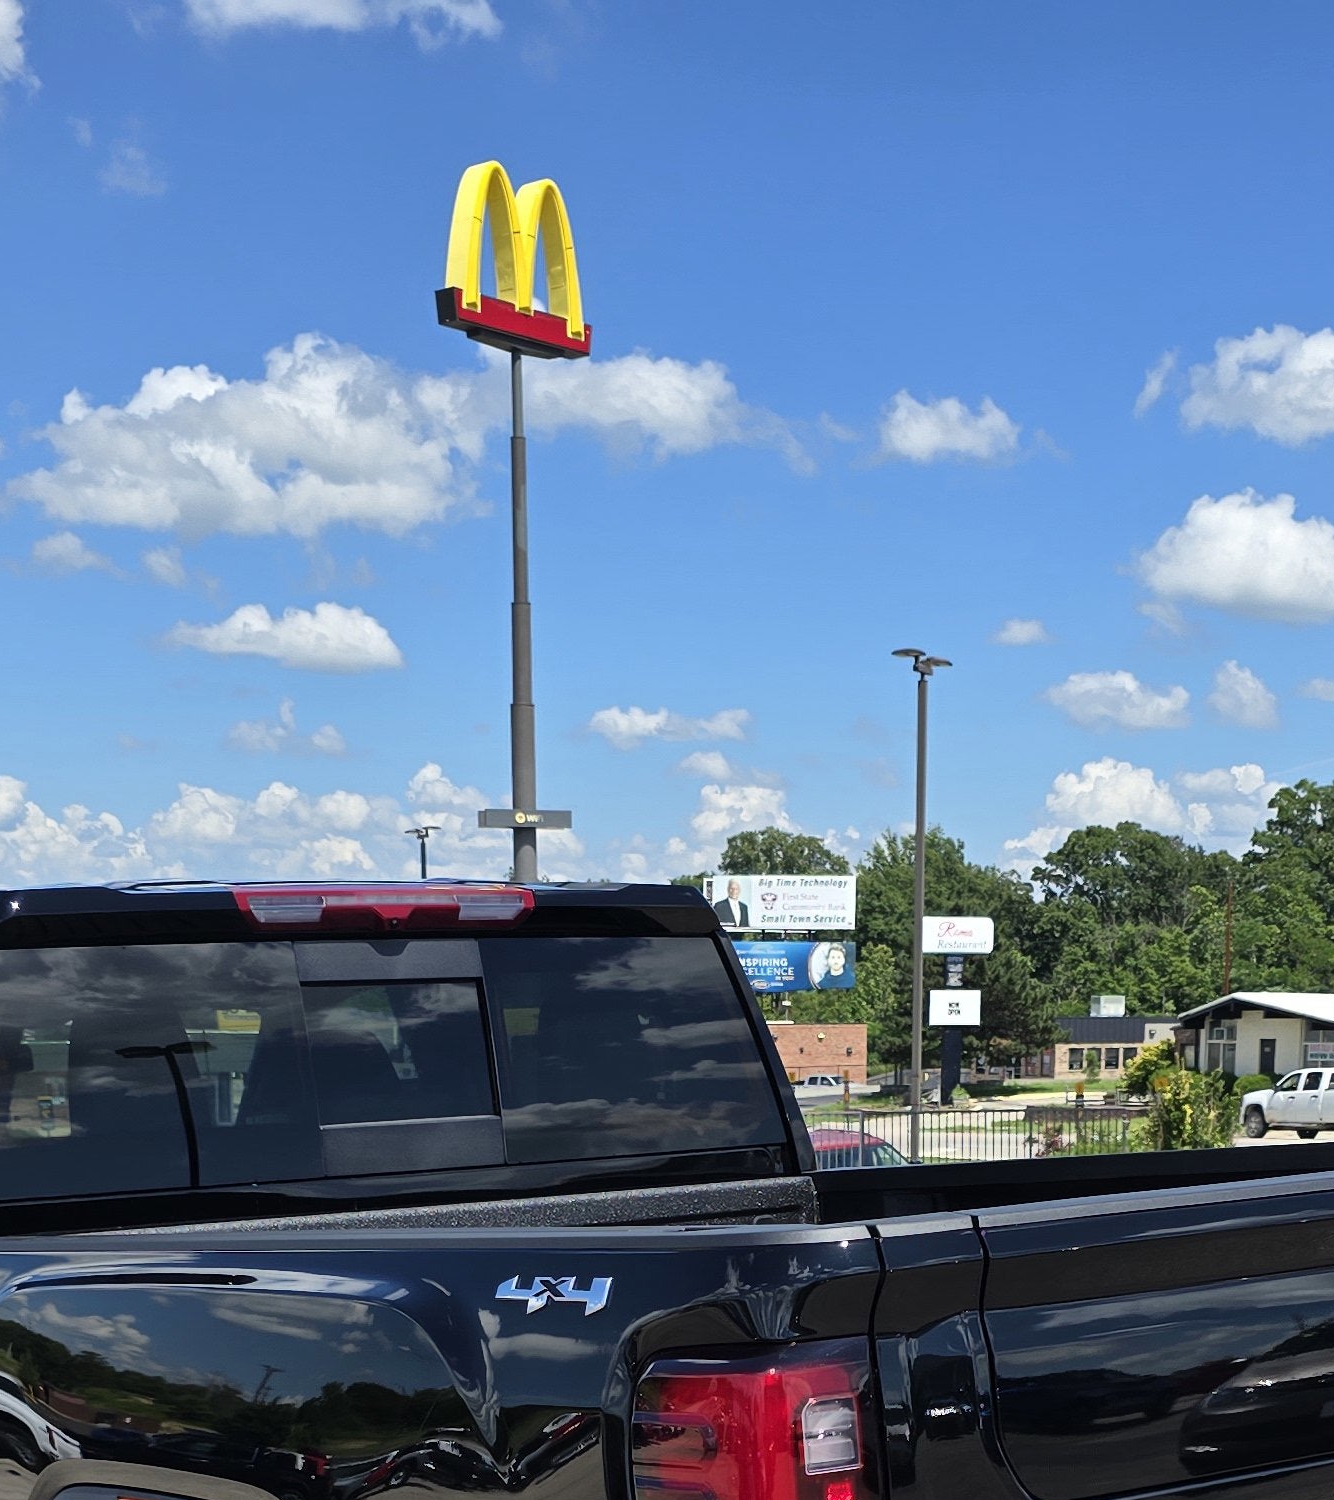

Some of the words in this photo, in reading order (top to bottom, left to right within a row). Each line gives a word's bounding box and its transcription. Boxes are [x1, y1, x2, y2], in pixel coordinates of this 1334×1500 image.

[759, 879, 772, 888] Big
[776, 879, 796, 887] Time
[800, 879, 848, 888] Technology
[761, 915, 785, 923] Small
[789, 915, 811, 923] Town
[814, 915, 846, 923] Service
[738, 957, 788, 967] NSPIRING
[742, 967, 795, 976] CELLENCE
